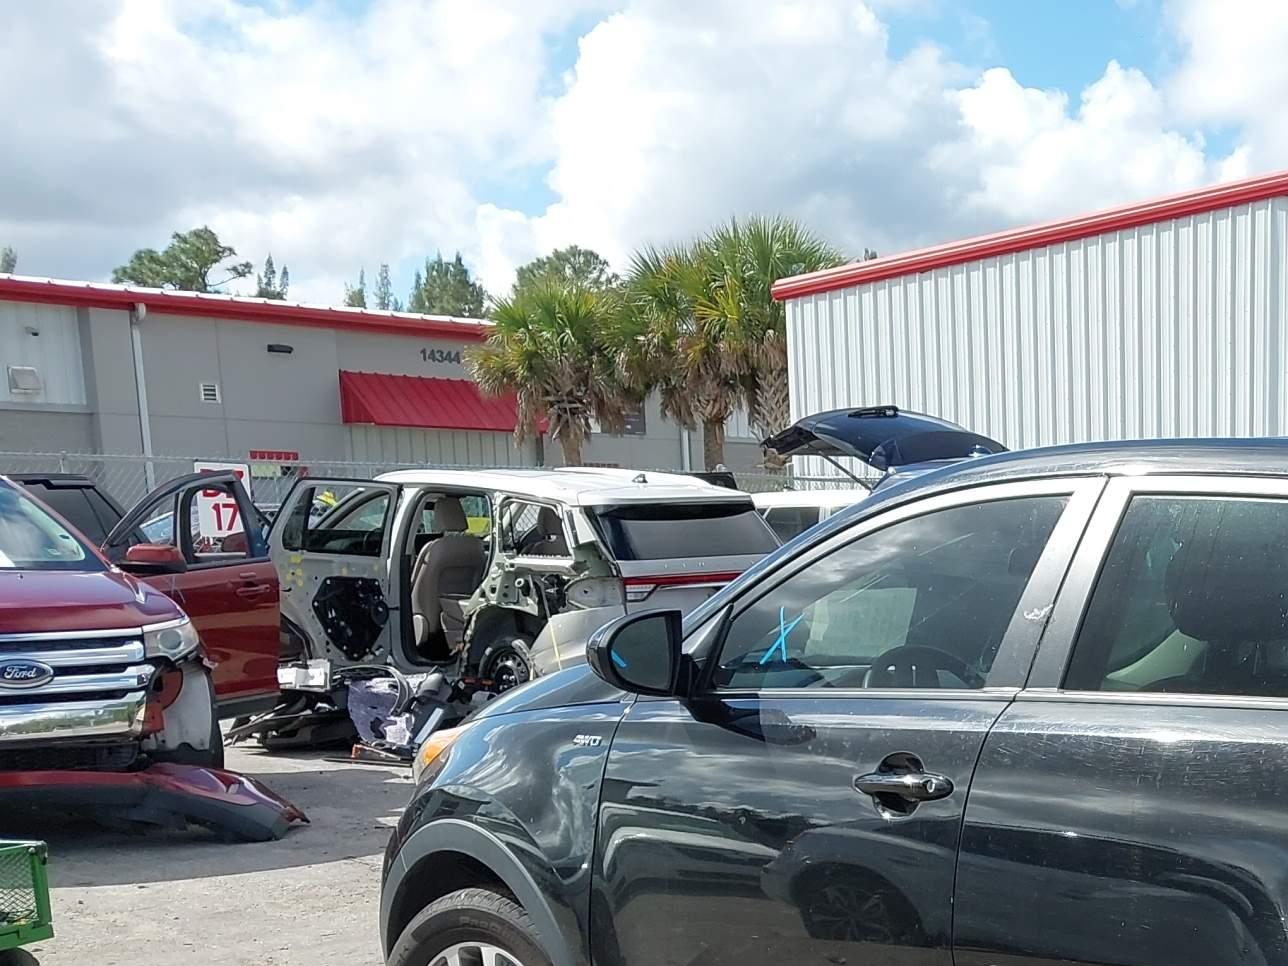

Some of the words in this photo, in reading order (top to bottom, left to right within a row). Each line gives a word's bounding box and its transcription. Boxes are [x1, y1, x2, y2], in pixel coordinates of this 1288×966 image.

[420, 347, 461, 365] 14344
[211, 502, 240, 531] 17
[4, 664, 37, 679] Ford
